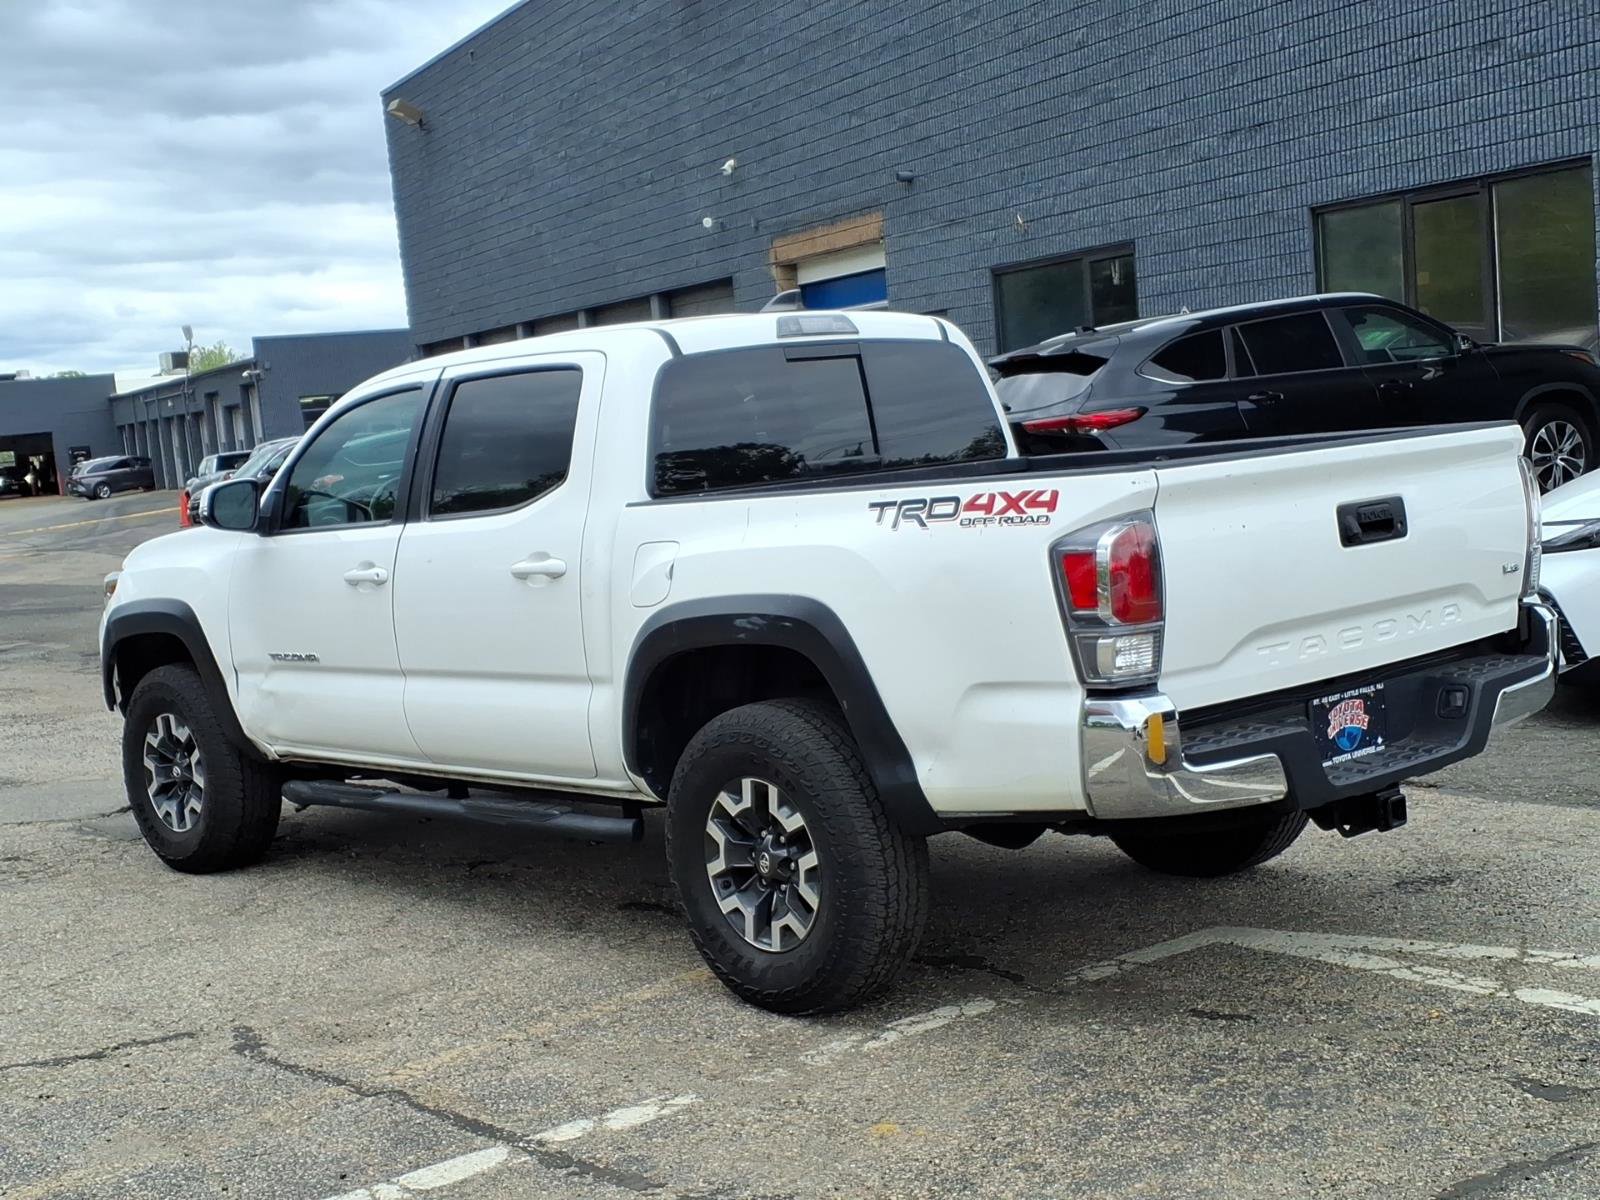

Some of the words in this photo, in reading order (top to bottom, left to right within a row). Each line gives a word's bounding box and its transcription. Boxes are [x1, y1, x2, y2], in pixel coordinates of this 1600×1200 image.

[868, 496, 961, 530] TRD
[962, 489, 1060, 516] 4X4
[959, 516, 996, 528] OFF
[998, 514, 1050, 526] ROAD
[1256, 603, 1463, 666] TACOMA
[1344, 688, 1359, 698] LITTLE
[1376, 682, 1384, 690] NJ
[1328, 699, 1365, 720] TOYOTA
